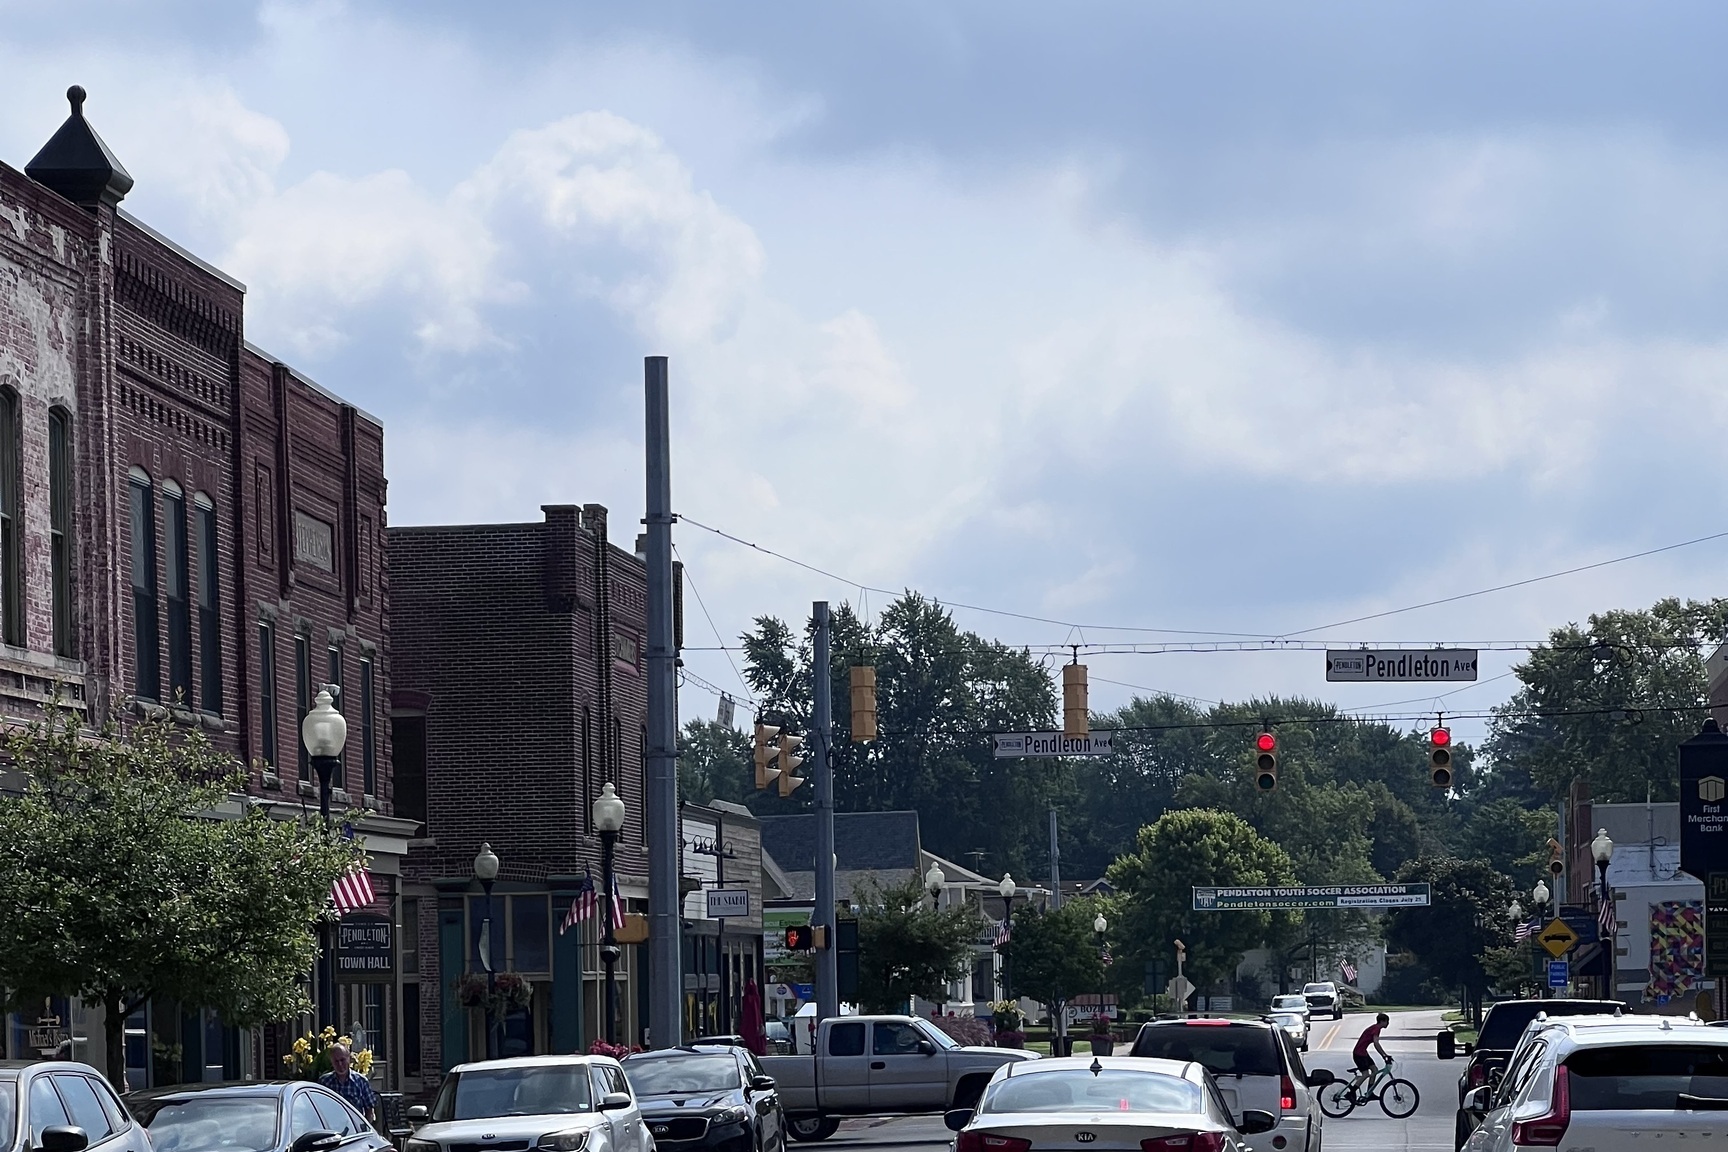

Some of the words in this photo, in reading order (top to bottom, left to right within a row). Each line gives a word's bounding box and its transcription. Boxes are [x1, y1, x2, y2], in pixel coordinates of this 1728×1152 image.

[1366, 654, 1449, 677] Pendleton
[1454, 660, 1470, 671] Ave
[1025, 734, 1091, 754] Pendleton
[1094, 738, 1107, 748] Ave
[1703, 805, 1720, 813] First
[1700, 824, 1723, 832] Bank
[1217, 889, 1271, 897] PENDLETON
[1273, 888, 1305, 896] YOUTH
[1307, 887, 1342, 895] SOCCER
[1344, 886, 1406, 895] ASSOCIATION
[342, 927, 387, 945] PENDLETON
[339, 956, 365, 969] TOWN
[368, 956, 390, 969] HALL
[1078, 1133, 1093, 1141] KIA
